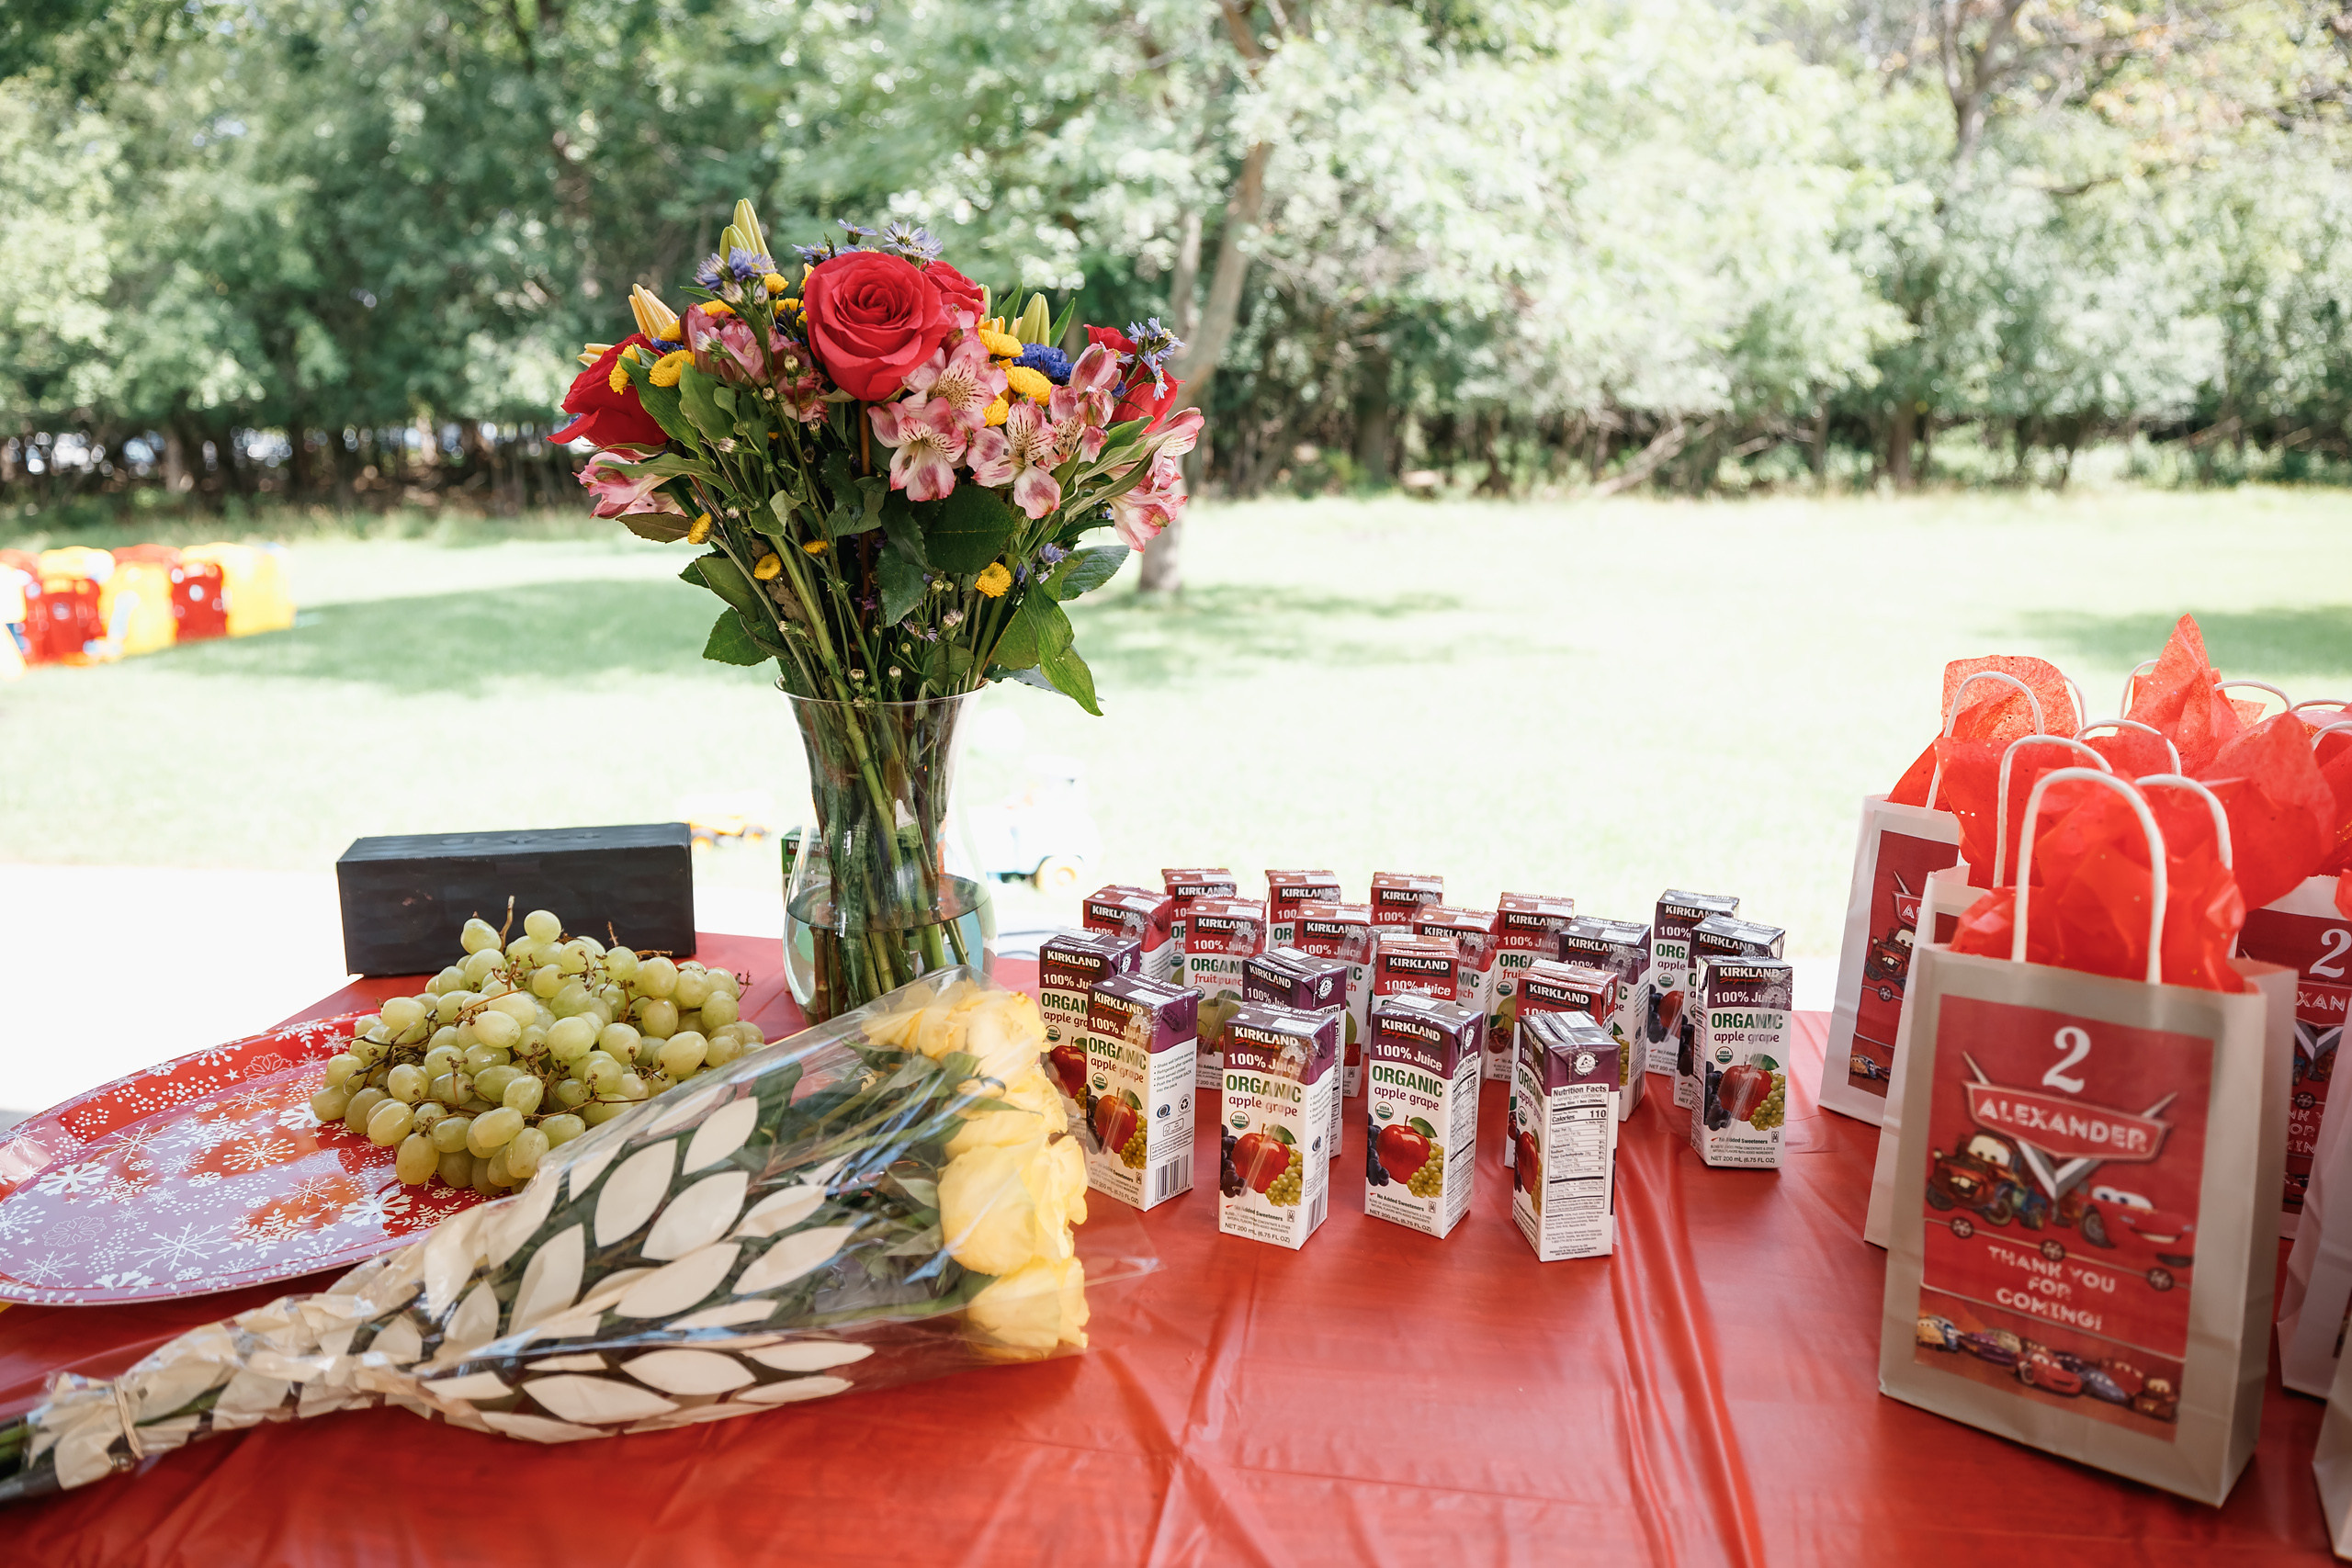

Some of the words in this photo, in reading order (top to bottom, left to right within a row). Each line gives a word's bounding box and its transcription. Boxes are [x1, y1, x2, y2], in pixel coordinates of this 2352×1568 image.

[1277, 909, 1296, 919] 100
[1378, 911, 1406, 921] 100%
[1665, 905, 1713, 919] KIRKLAN
[1198, 918, 1251, 930] KIRKLAND
[1659, 926, 1690, 938] 100%
[1193, 940, 1224, 950] 100%
[1302, 944, 1331, 954] 100%
[1503, 936, 1532, 947] 100%
[1699, 932, 1756, 953] KIRKLAND
[1047, 950, 1101, 968] KIRKLAND
[2309, 928, 2352, 978] 2
[1389, 957, 1449, 970] KIRKLAND
[1657, 960, 1685, 970] apple
[1250, 964, 1291, 988] KIRKLAND
[1719, 966, 1780, 978] KIRKLAND
[1044, 974, 1074, 987] 100%
[1194, 974, 1217, 985] fruit
[1218, 976, 1242, 987] punc
[1385, 980, 1418, 991] 100%
[1420, 982, 1451, 996] Juice
[1248, 987, 1272, 1004] 100%
[1529, 984, 1589, 1005] KIRKLAND
[1714, 991, 1748, 1003] 100%
[1041, 992, 1088, 1015] ORGAN
[1094, 991, 1144, 1015] KIRKLAND
[1044, 1011, 1071, 1023] apple
[1091, 1016, 1119, 1034] 100%
[1712, 1013, 1783, 1029] ORGANIC
[1235, 1026, 1299, 1046] KIRKLAND
[1381, 1019, 1441, 1042] KIRKLAND
[1713, 1032, 1745, 1043] apple
[1747, 1032, 1780, 1044] grape
[1088, 1037, 1147, 1071] ORGANIC
[1229, 1053, 1266, 1068] 100%
[1376, 1043, 1412, 1060] 100%
[1414, 1051, 1442, 1072] Juice
[2041, 1025, 2091, 1093] 2
[1091, 1057, 1116, 1071] apple
[1119, 1066, 1144, 1083] grape
[1226, 1074, 1302, 1103] ORGANIC
[1373, 1066, 1443, 1098] ORGANIC
[1374, 1087, 1407, 1100] apple
[1409, 1095, 1440, 1111] grape
[1554, 1087, 1583, 1097] Nutrition
[1586, 1085, 1607, 1093] Facts
[1228, 1096, 1261, 1109] apple
[1265, 1102, 1297, 1117] grape
[1552, 1114, 1575, 1123] Calories
[1589, 1110, 1606, 1119] 110
[1978, 1098, 2147, 1154] ALEXANDER
[2289, 1122, 2315, 1138] OR
[1384, 1195, 1397, 1203] Added
[1397, 1200, 1424, 1212] Sweeteners
[1256, 1211, 1283, 1222] Sweeteners
[1225, 1222, 1237, 1230] NET
[1987, 1245, 2063, 1279] THANK
[2069, 1266, 2116, 1293] YOU
[2027, 1276, 2072, 1301] FOR
[1996, 1288, 2102, 1331] COMING!
